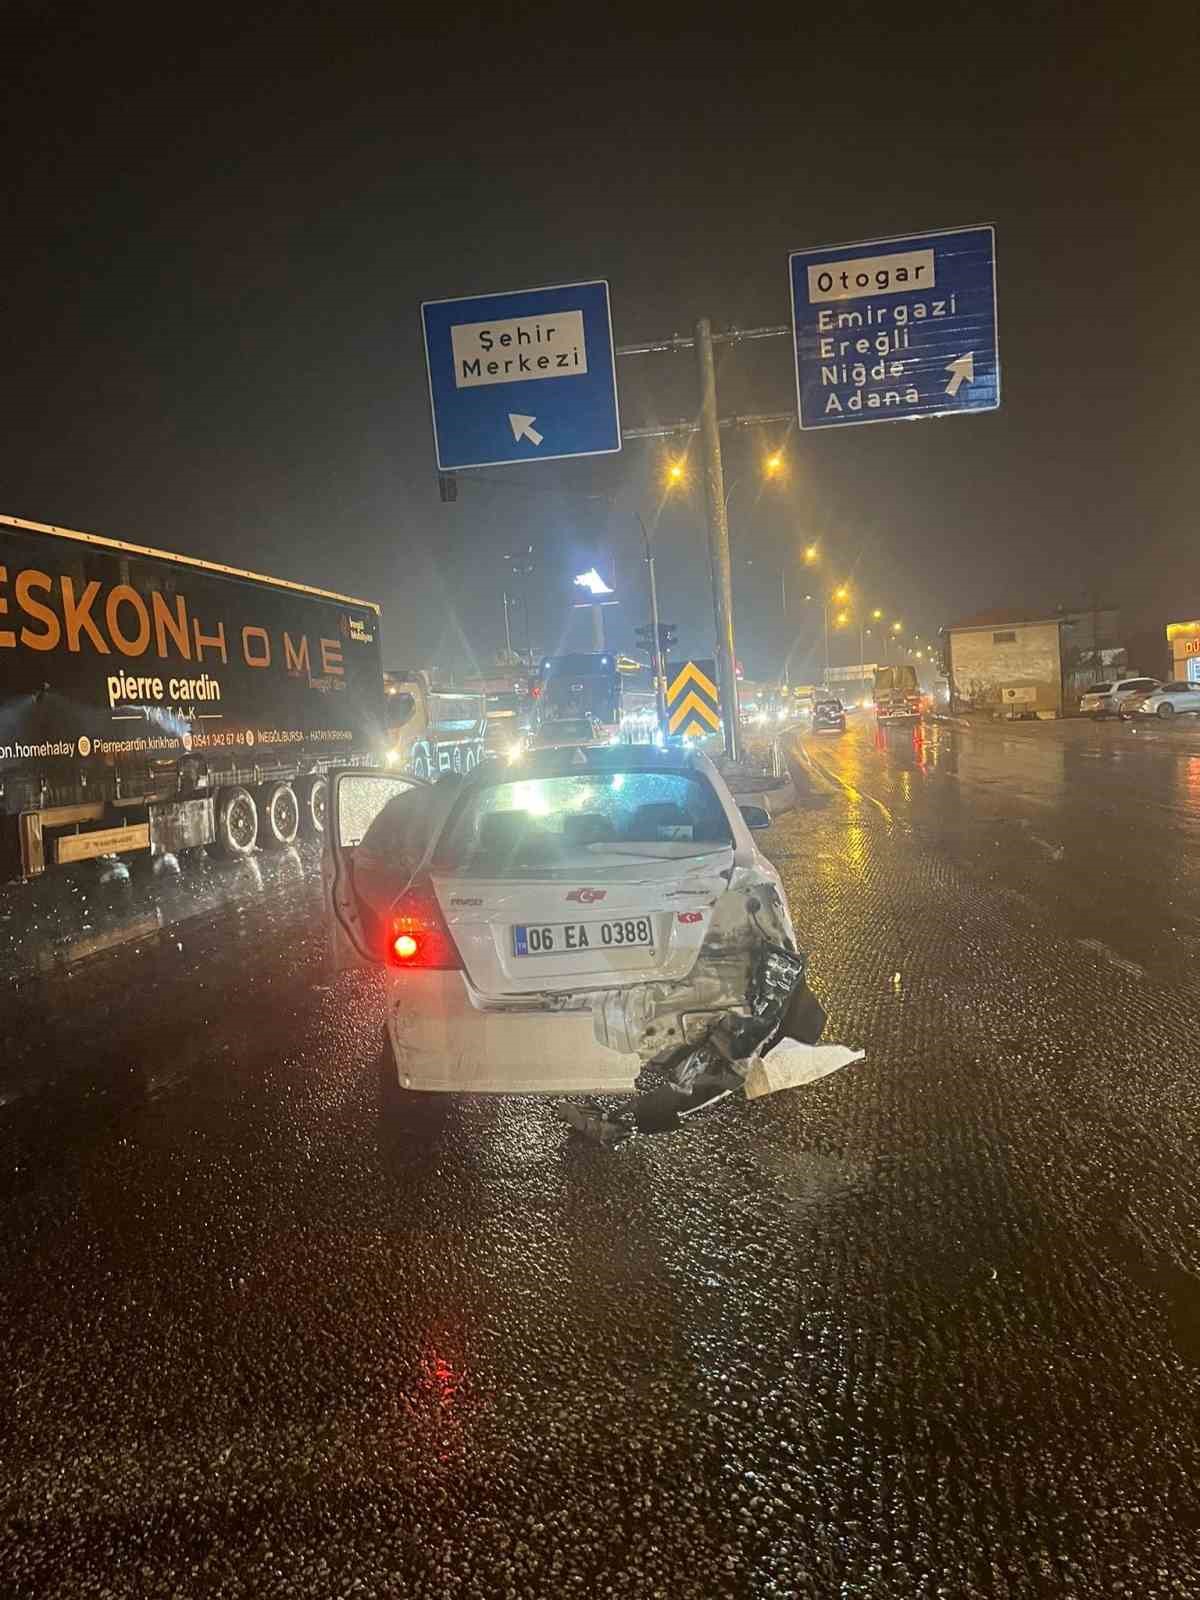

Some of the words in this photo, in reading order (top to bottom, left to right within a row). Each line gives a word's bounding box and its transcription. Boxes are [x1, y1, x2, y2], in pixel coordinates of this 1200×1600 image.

[817, 264, 925, 293] Otogar
[818, 293, 956, 331] Emirgazi
[479, 324, 556, 352] Şehir
[819, 328, 909, 358] Ereğli
[462, 346, 579, 378] Merkezi
[821, 358, 905, 387] Niğde
[824, 387, 919, 414] Adana
[192, 617, 346, 675] HOME
[107, 669, 164, 709] pierre
[168, 673, 221, 701] cardin
[143, 705, 197, 721] YATAK
[529, 925, 553, 951] 06
[565, 924, 589, 949] EA
[601, 920, 649, 945] 0388
